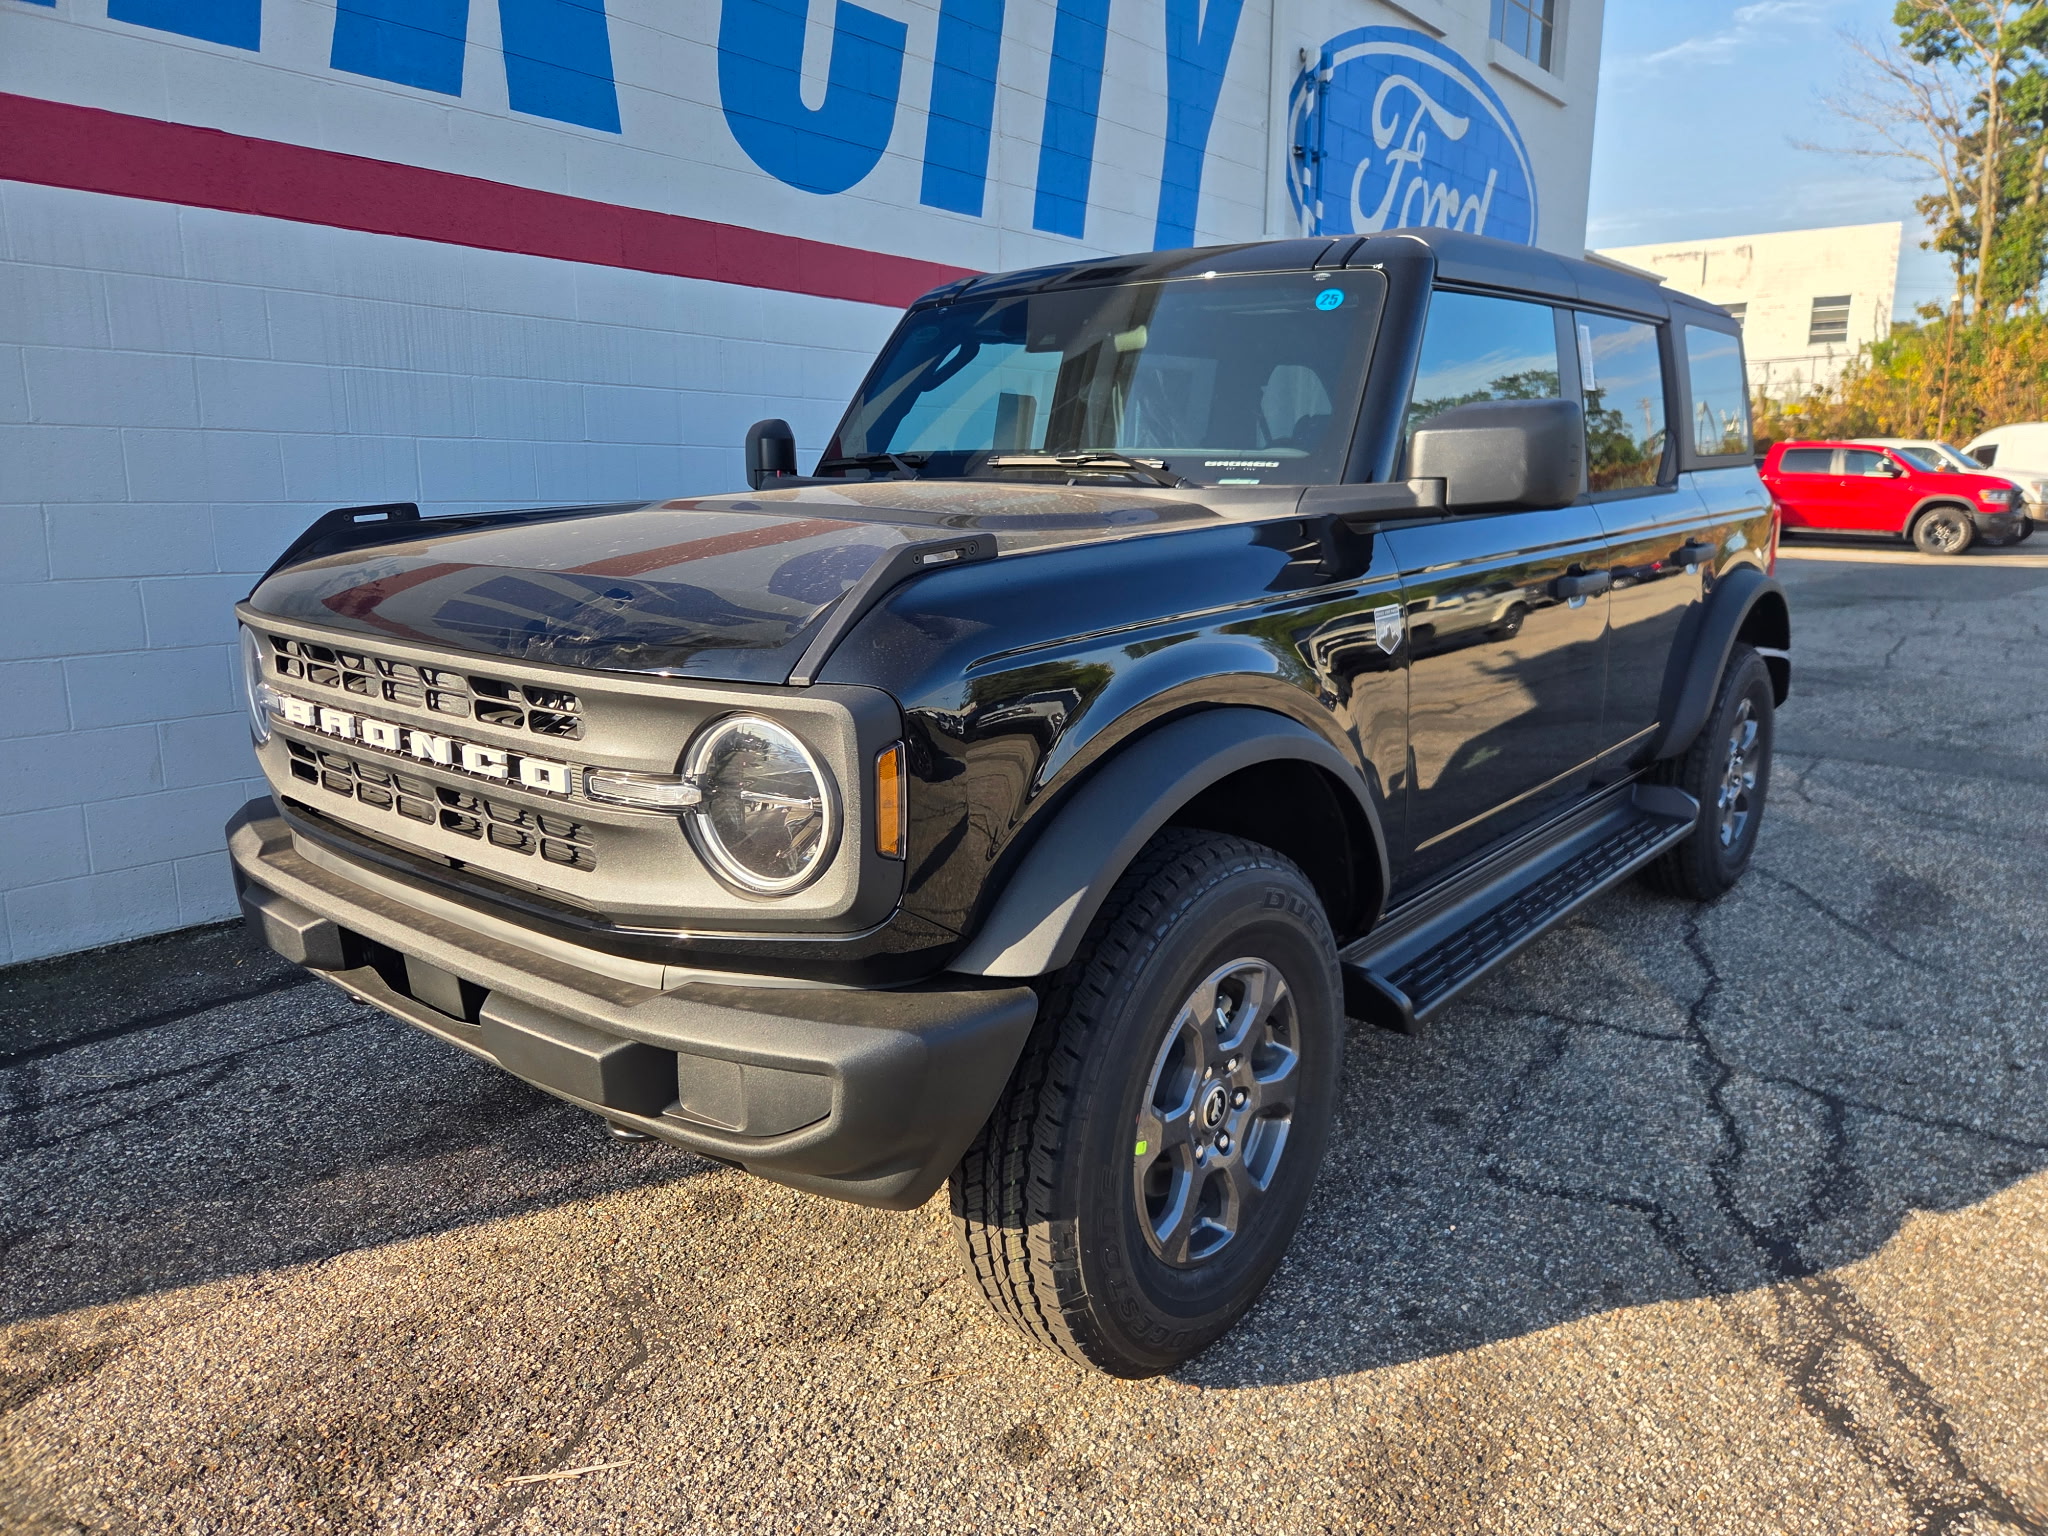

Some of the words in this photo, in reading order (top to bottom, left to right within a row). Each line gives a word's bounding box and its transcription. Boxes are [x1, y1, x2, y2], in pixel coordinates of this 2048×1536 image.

[1351, 74, 1498, 235] Ford
[1319, 293, 1340, 306] 25
[284, 697, 571, 794] BRONCO
[1101, 1166, 1222, 1349] IDGESTONE
